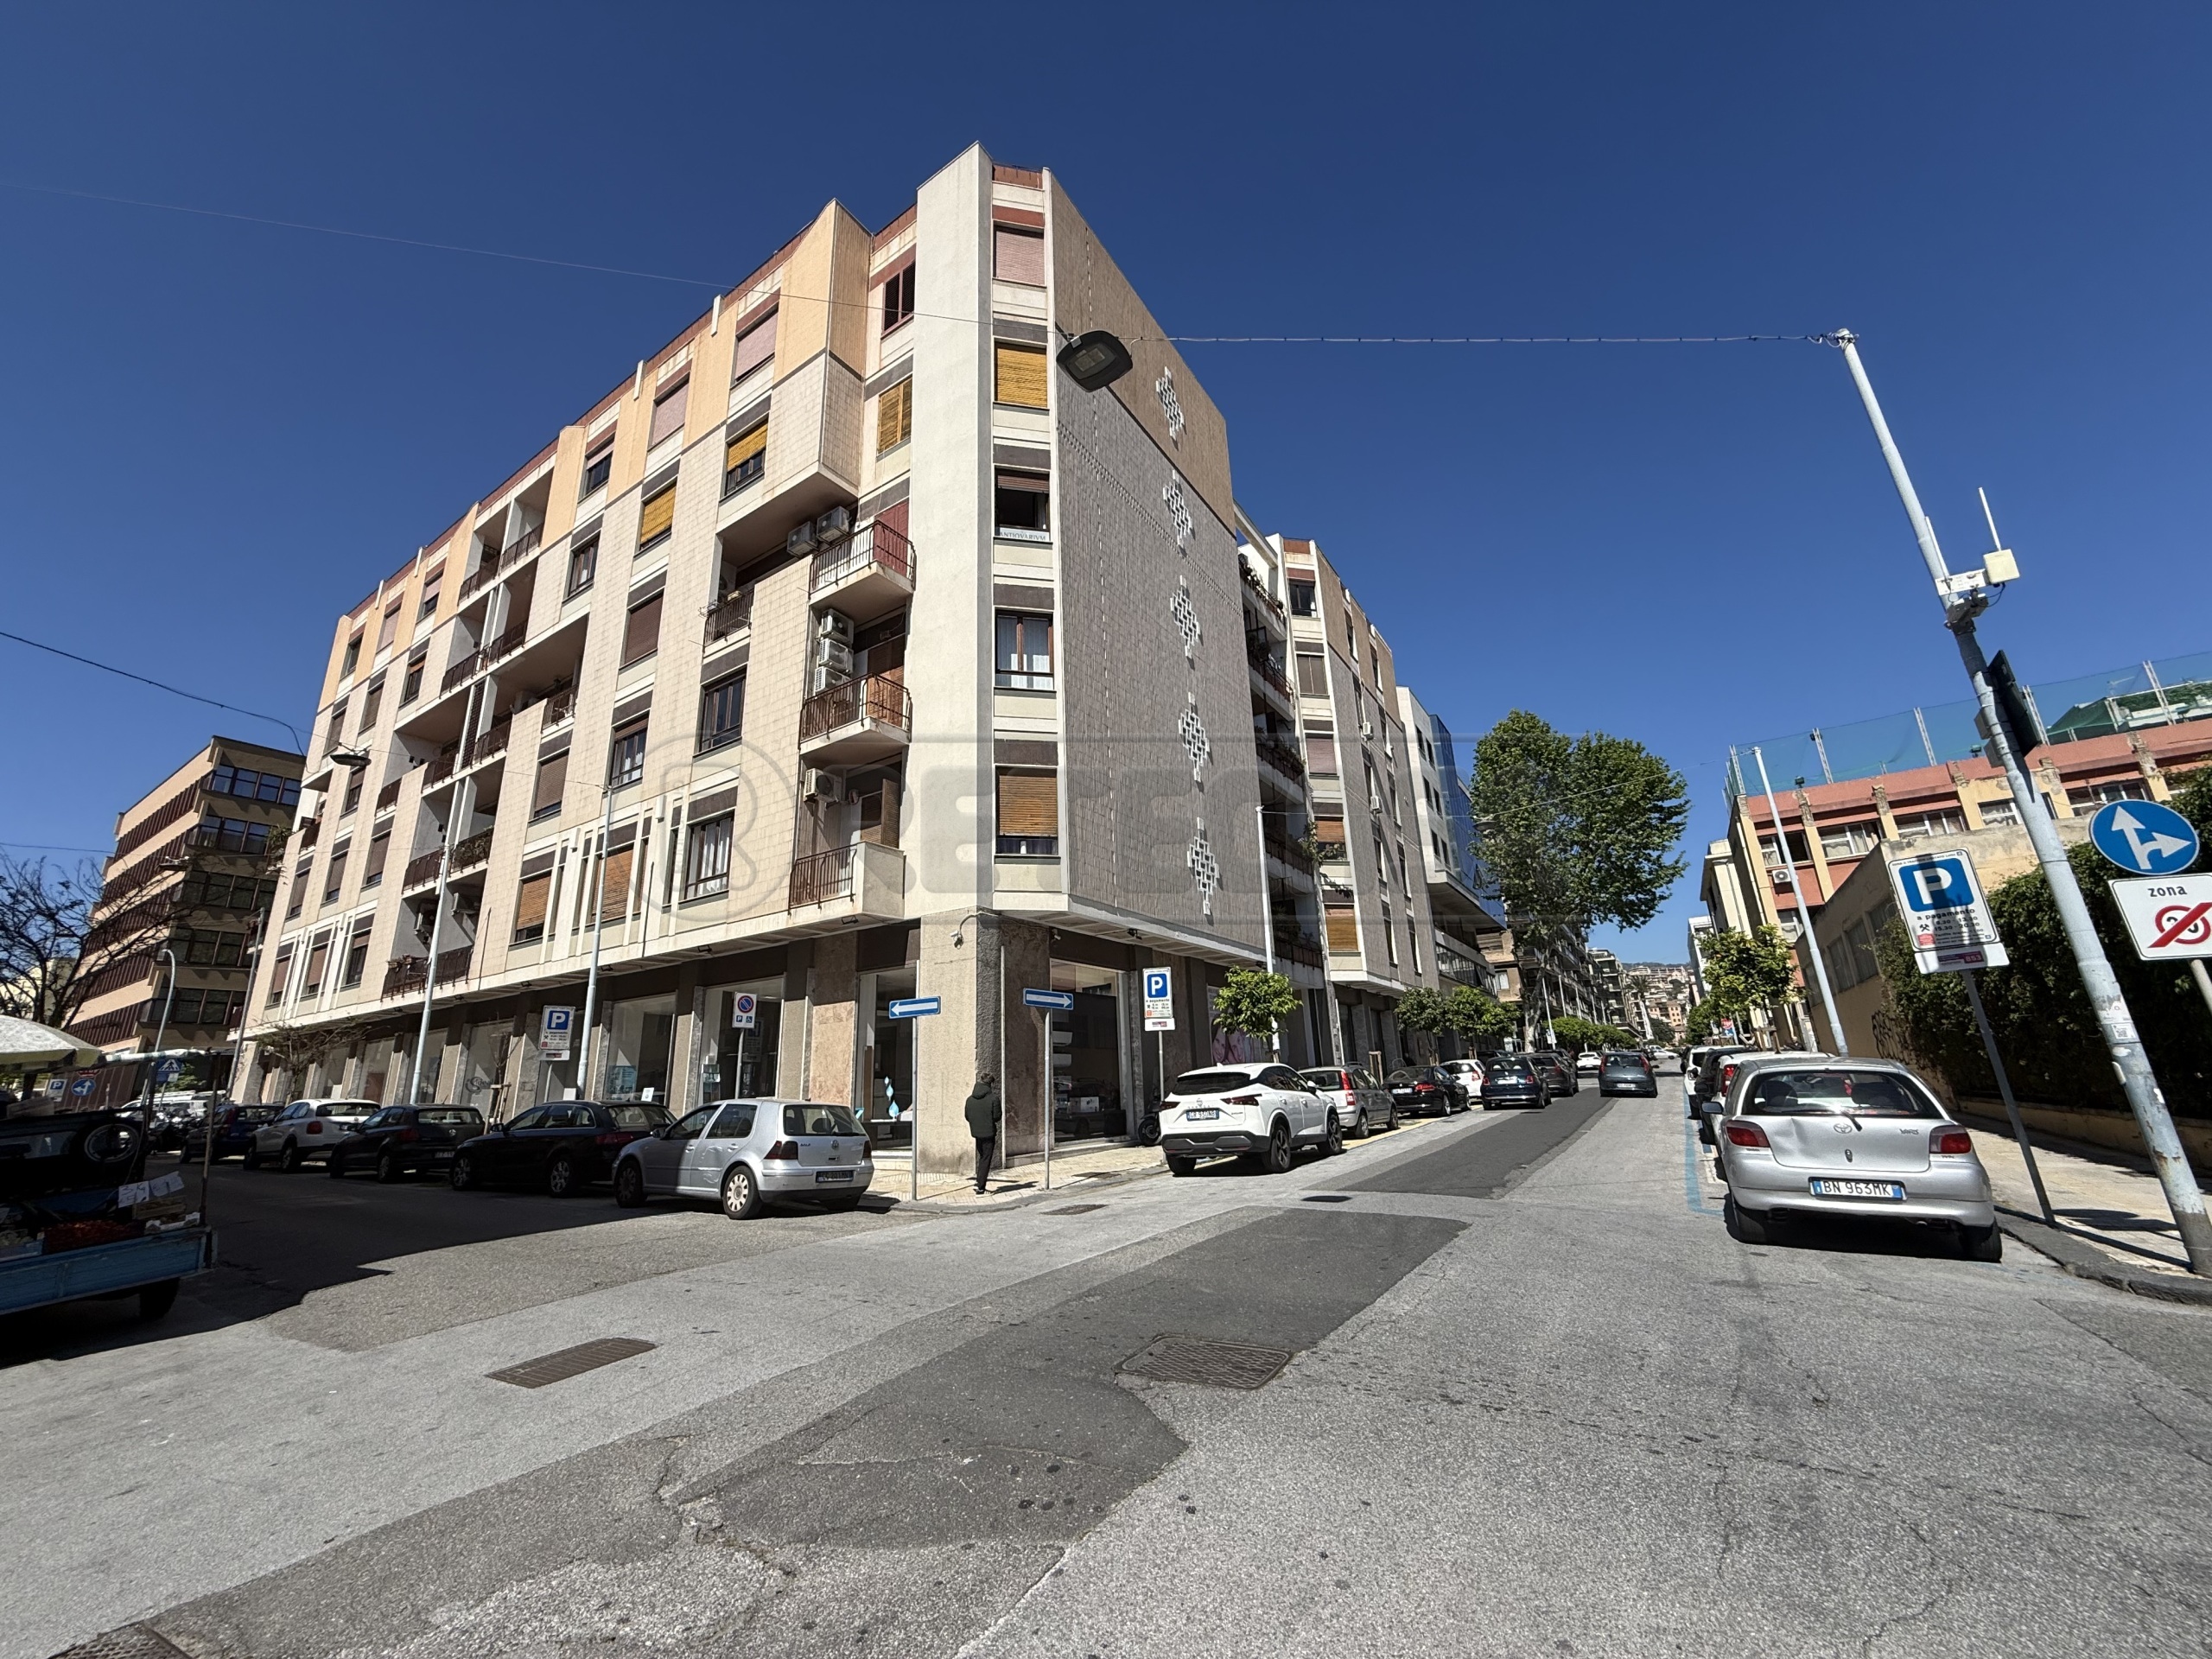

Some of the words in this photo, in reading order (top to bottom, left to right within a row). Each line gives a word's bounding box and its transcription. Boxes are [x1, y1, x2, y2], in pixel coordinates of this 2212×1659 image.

[1912, 867, 1952, 905] P
[2147, 886, 2187, 898] zona
[1925, 908, 1975, 921] pagamento
[1151, 976, 1163, 995] P
[550, 1012, 566, 1028] P
[1823, 1180, 1842, 1193] BN
[1847, 1183, 1891, 1196] 963MK
